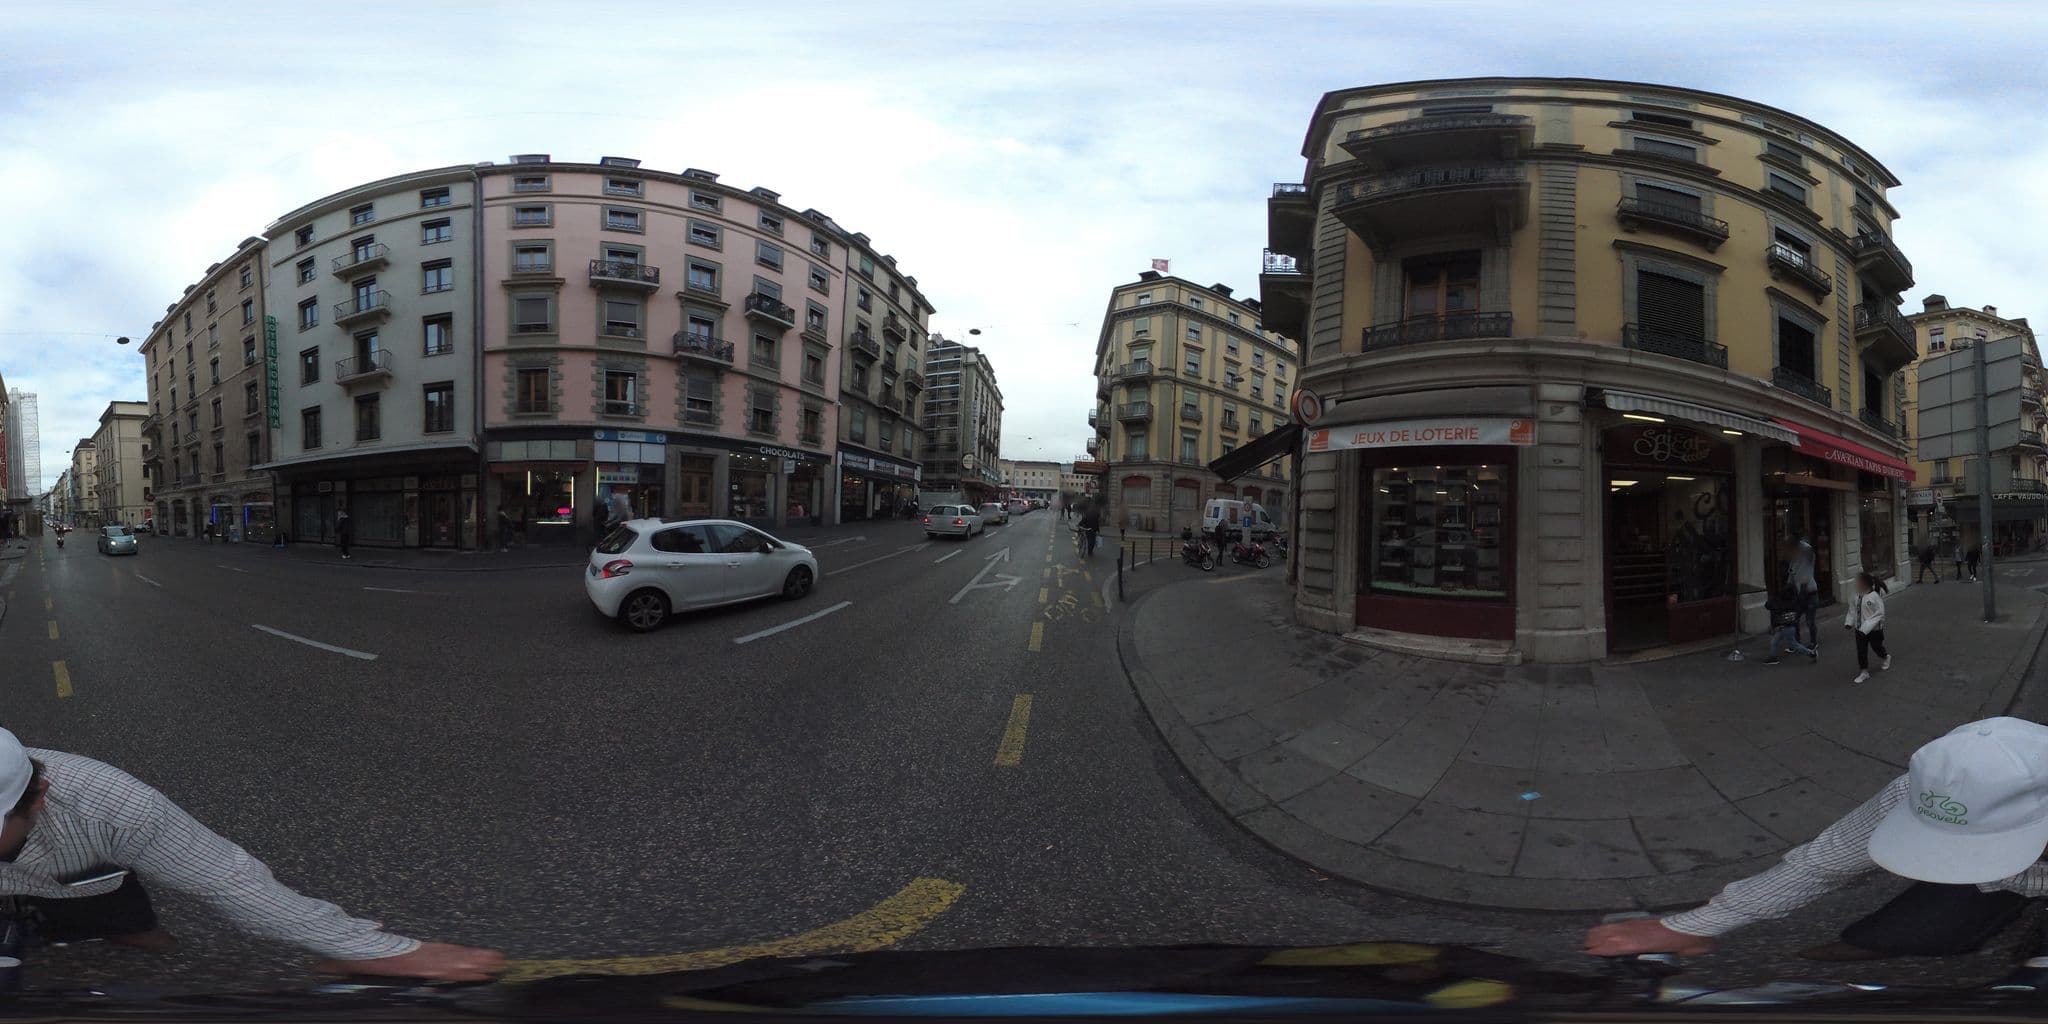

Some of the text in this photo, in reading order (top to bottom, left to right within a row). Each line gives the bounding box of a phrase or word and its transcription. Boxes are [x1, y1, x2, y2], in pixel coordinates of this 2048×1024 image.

[269, 316, 280, 429] HOTEL MONTANA
[1351, 427, 1479, 445] JEUX DE LOTERIE
[760, 446, 805, 460] CHOCOLATS
[1865, 460, 1882, 473] TAPIS
[1918, 806, 1968, 826] geovelo
